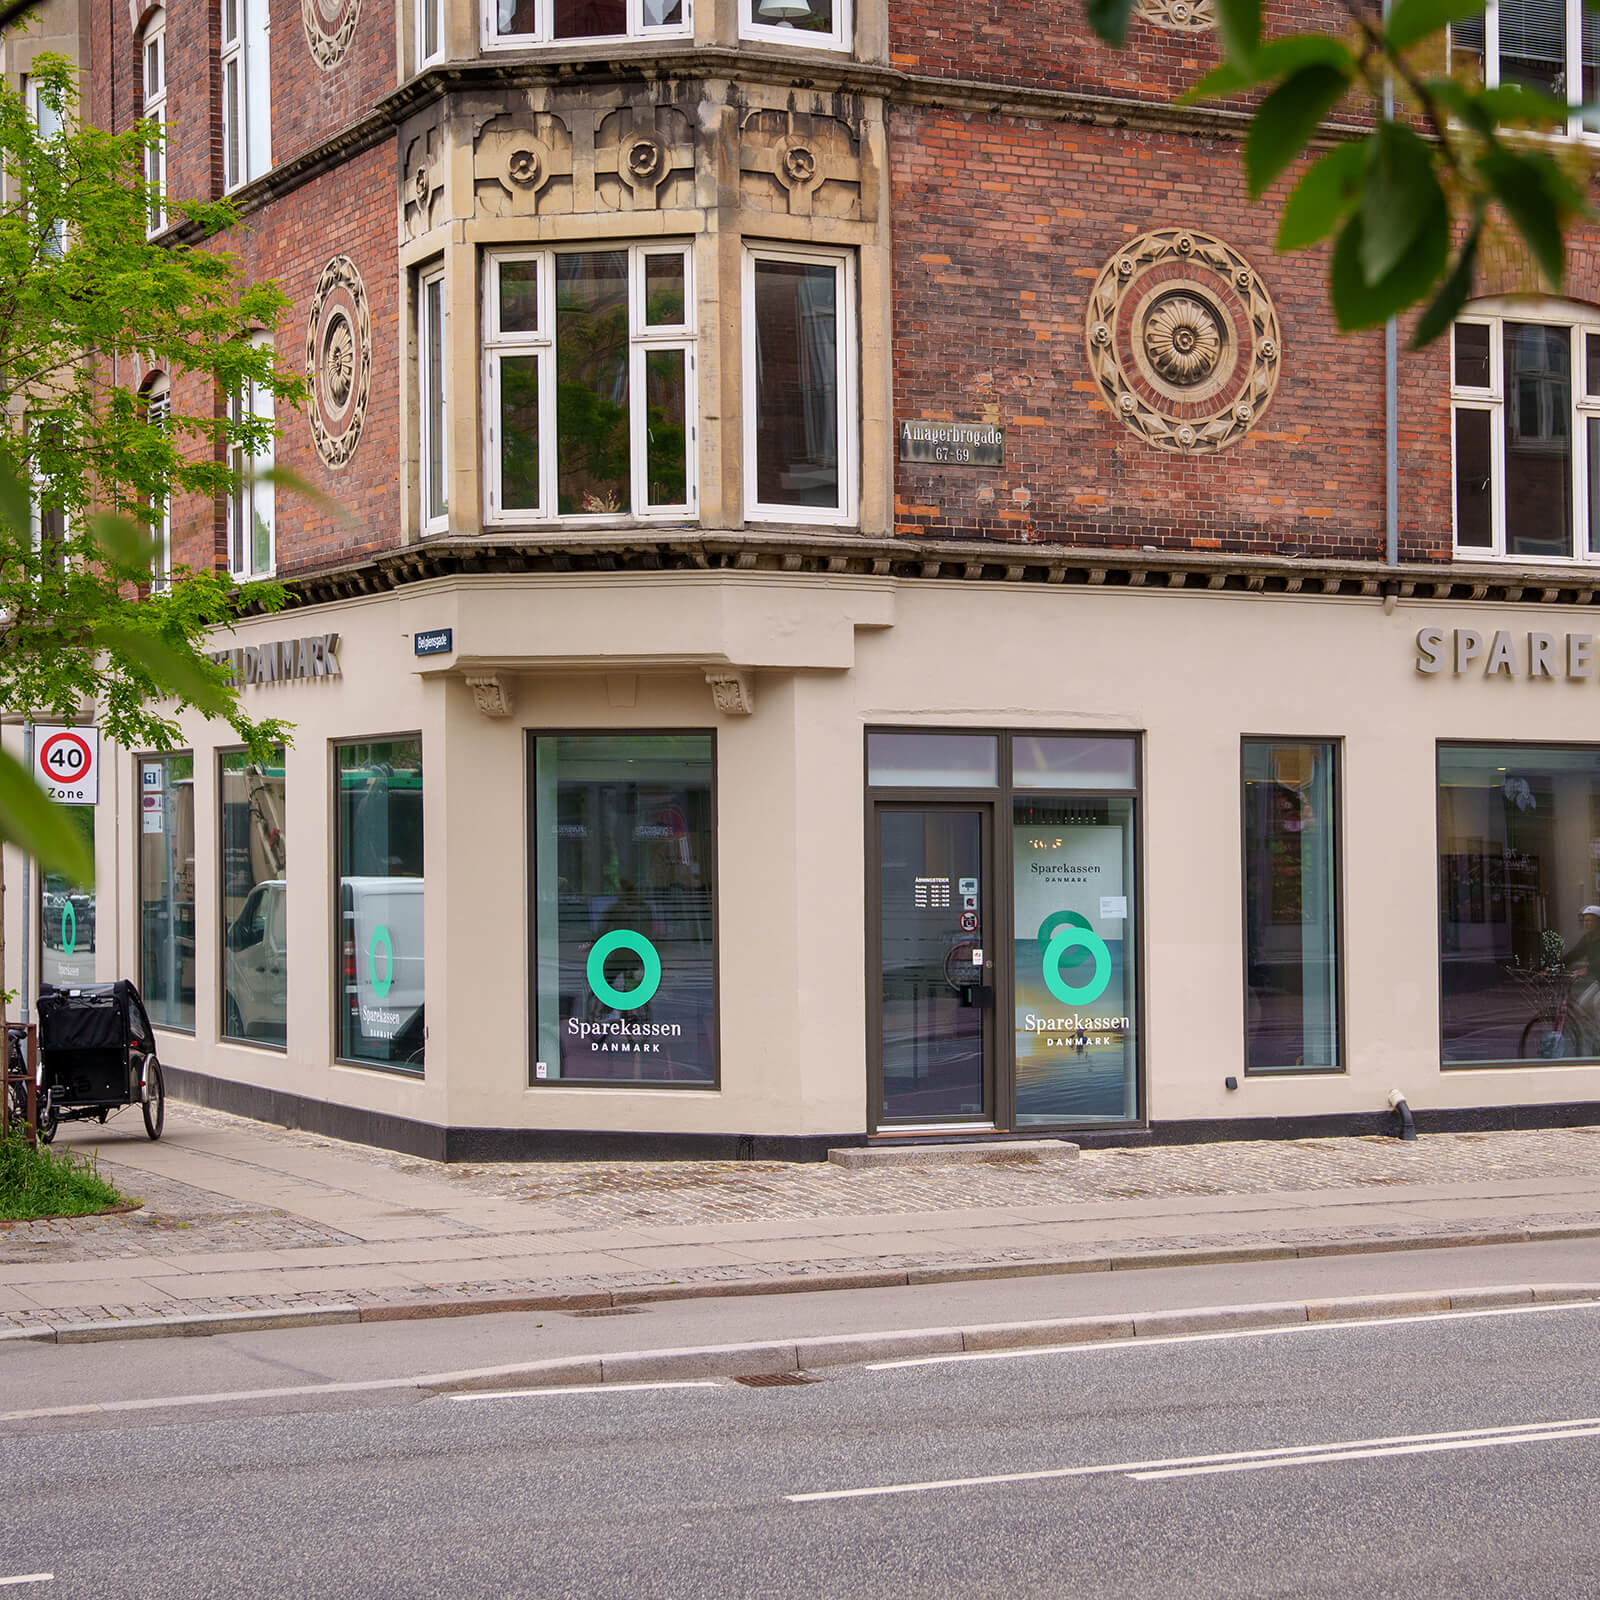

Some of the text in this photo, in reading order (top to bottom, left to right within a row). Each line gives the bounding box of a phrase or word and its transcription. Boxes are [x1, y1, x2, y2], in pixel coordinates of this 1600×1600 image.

[902, 423, 1002, 447] Amagerbrogade
[935, 447, 970, 462] 67-69
[417, 632, 448, 650] Belgiensgade
[244, 633, 341, 684] DANMARK
[49, 748, 83, 768] 40
[47, 787, 84, 799] Zone
[1030, 862, 1101, 875] Sparekassen
[362, 1004, 400, 1025] Sparekassen
[1025, 1013, 1130, 1035] Sparekassen
[568, 1017, 681, 1039] Sparekassen
[591, 1042, 660, 1053] DANMARK
[1047, 1036, 1111, 1047] DANMARK
